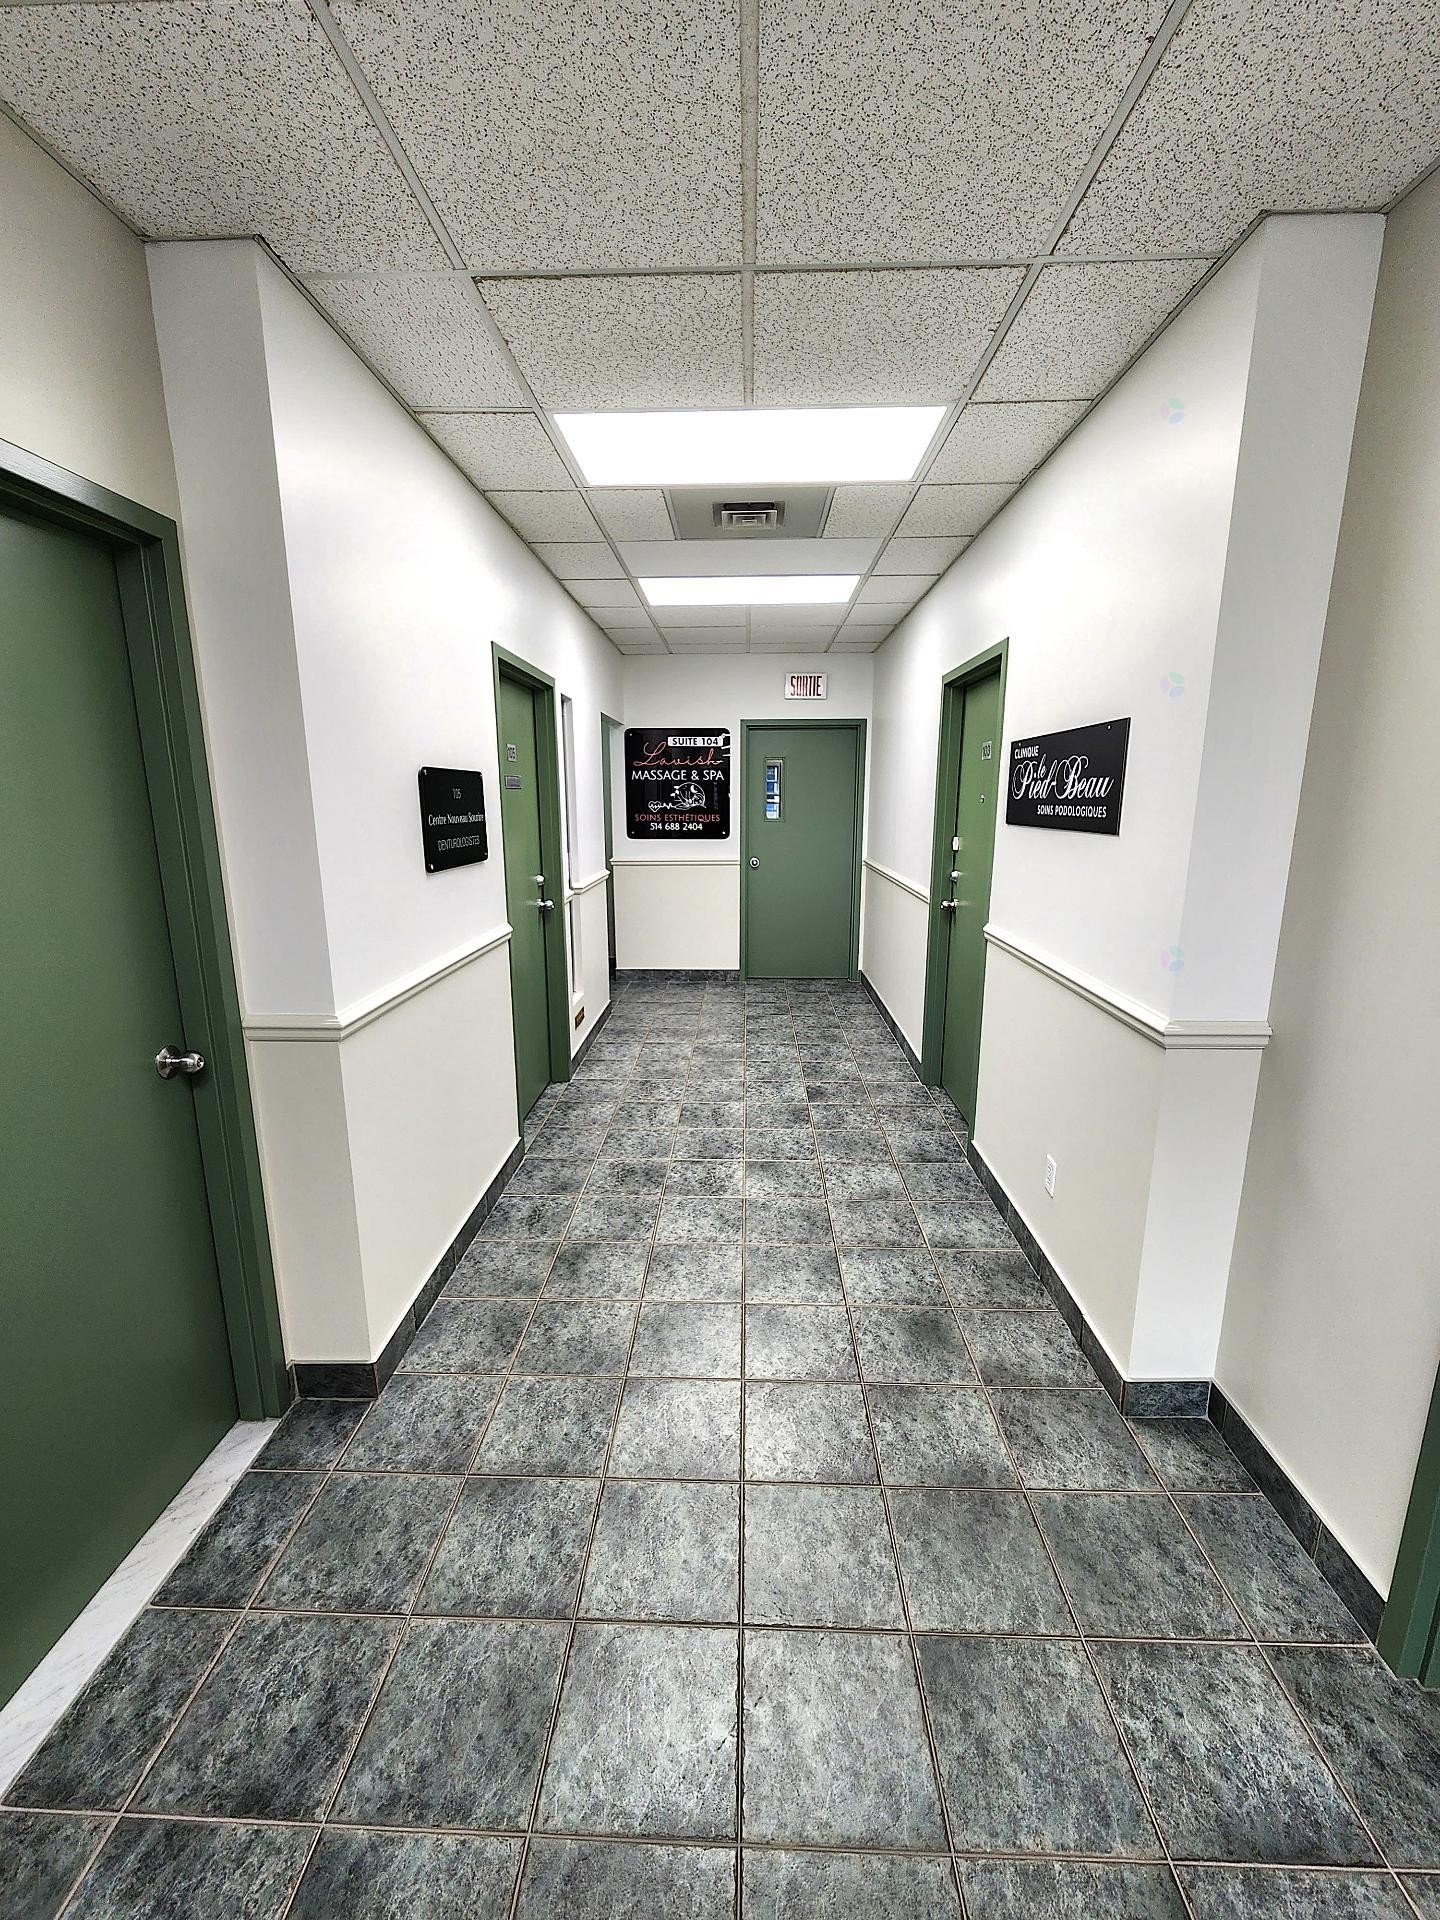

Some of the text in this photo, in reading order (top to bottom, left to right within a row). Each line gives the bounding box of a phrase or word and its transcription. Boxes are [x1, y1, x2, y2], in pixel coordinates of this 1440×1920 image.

[790, 675, 822, 697] SORTIE
[672, 737, 719, 746] SUITE 104
[633, 741, 723, 766] Lavish
[1014, 745, 1040, 760] CLINIQUE
[1037, 753, 1048, 779] le
[631, 769, 725, 781] MASSAGE & SPA
[1037, 804, 1107, 818] SOINS PODOLOGIQUES
[428, 814, 446, 826] Centre
[447, 813, 468, 824] Nouveau
[634, 814, 662, 823] SOINS
[649, 822, 704, 832] 514 688 2404
[438, 835, 480, 851] DENTUROLOGISTES
